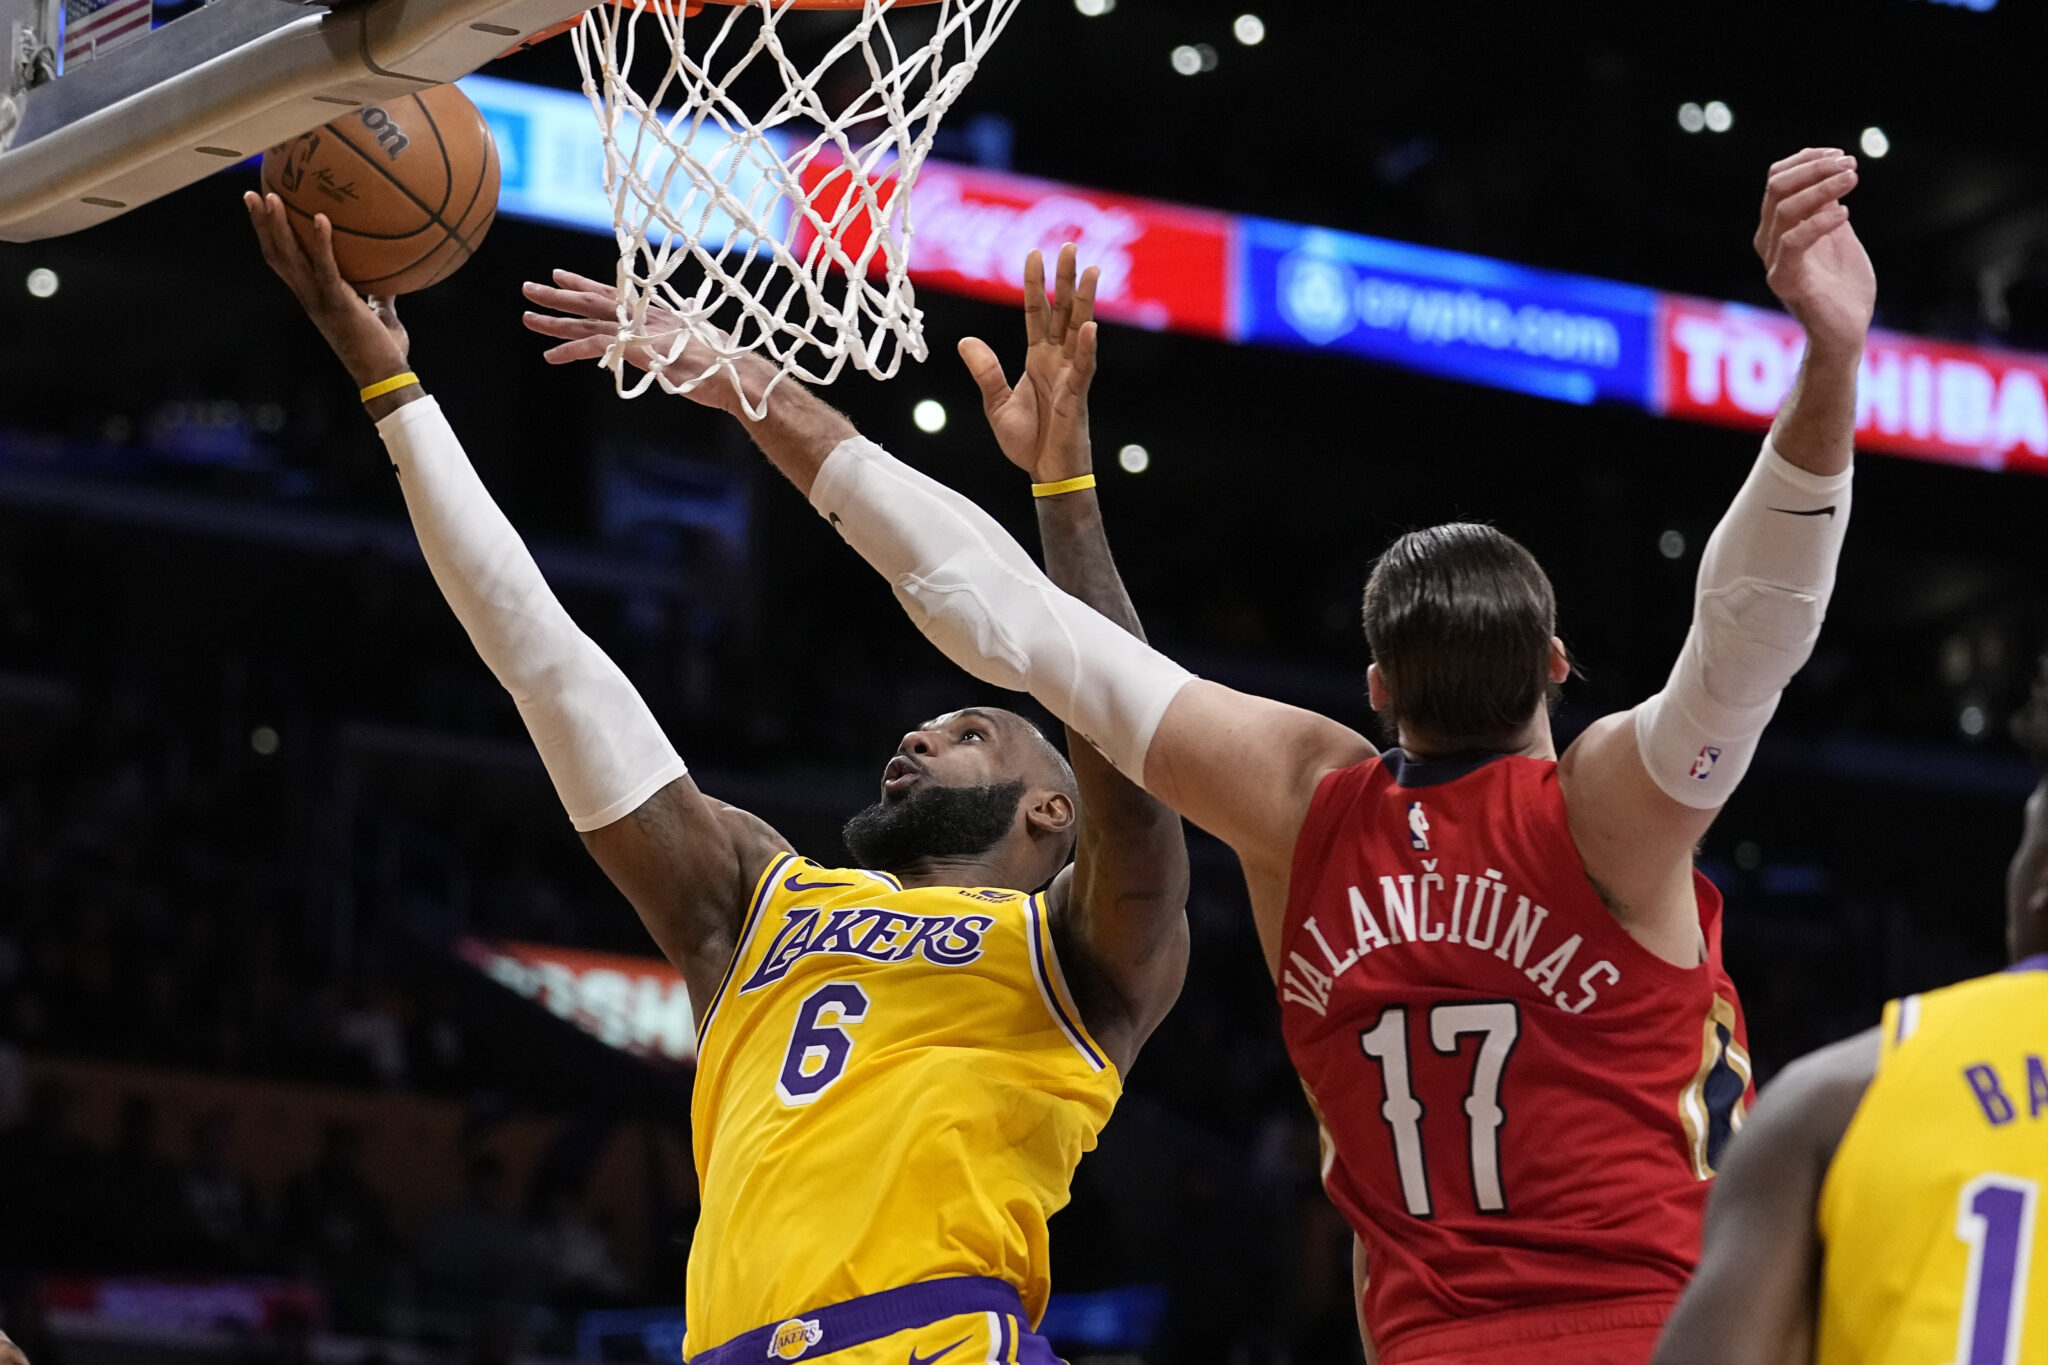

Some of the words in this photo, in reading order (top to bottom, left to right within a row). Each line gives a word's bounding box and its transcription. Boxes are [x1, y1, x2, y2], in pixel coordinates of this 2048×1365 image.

[362, 107, 411, 161] on
[1354, 277, 1621, 369] crypto.com
[1673, 316, 2048, 457] TOHIBA
[739, 906, 994, 995] LAKERS
[1283, 858, 1620, 1017] VALANČIŪNAS
[774, 980, 872, 1107] 6
[1358, 998, 1520, 1220] 17
[771, 1327, 817, 1354] LAKERS
